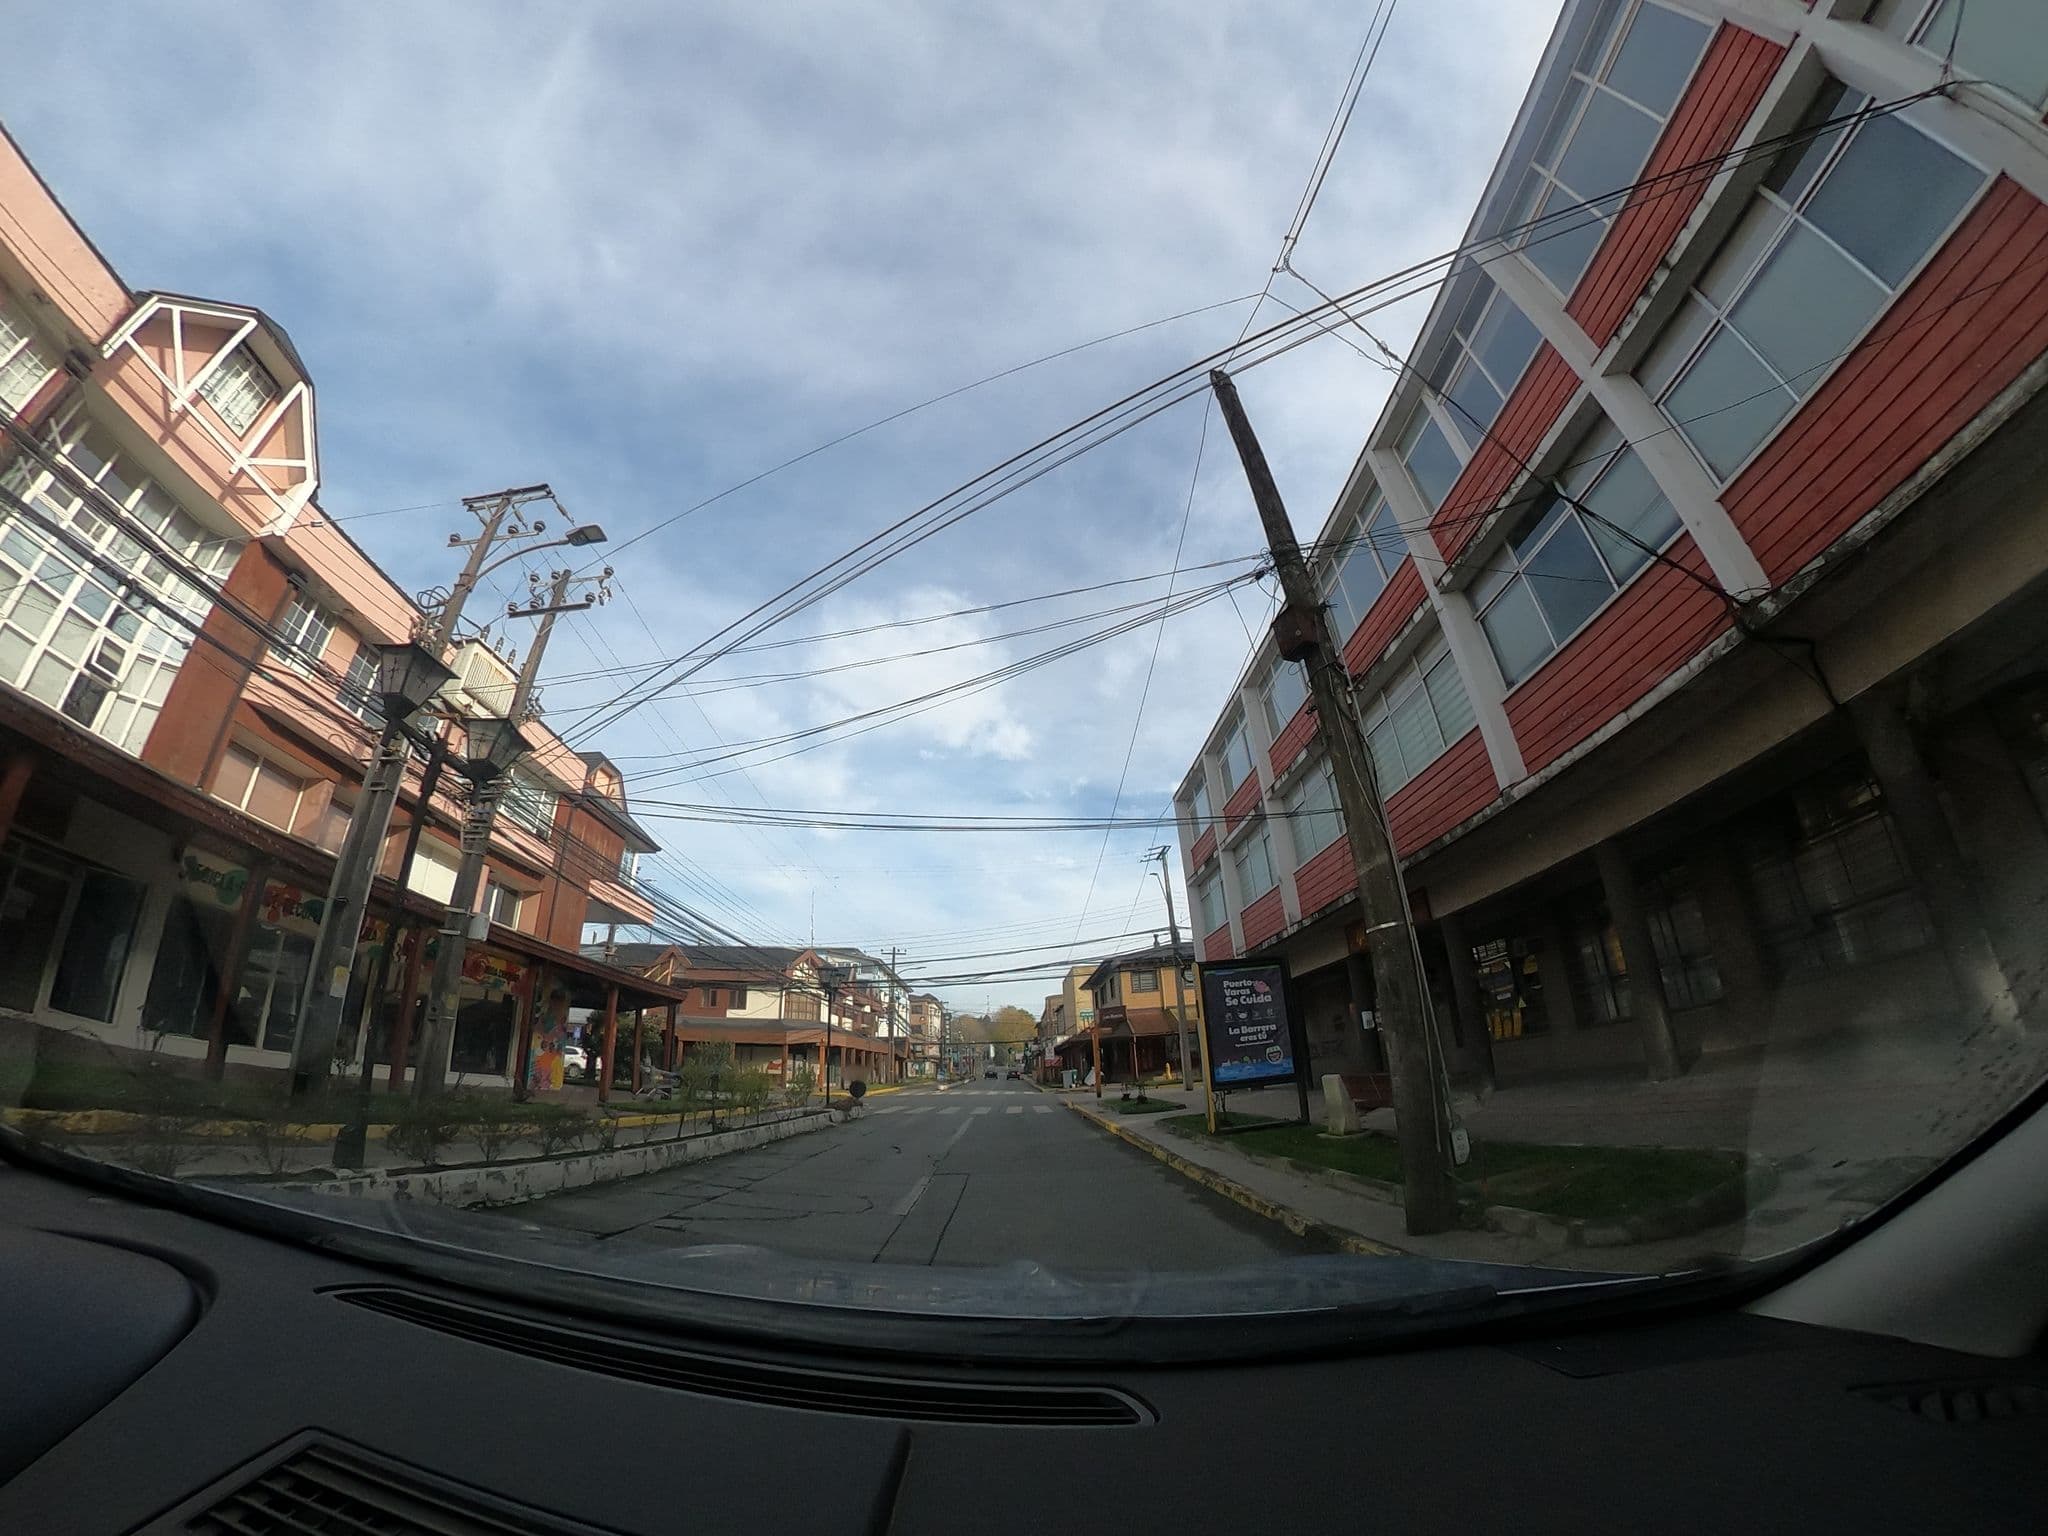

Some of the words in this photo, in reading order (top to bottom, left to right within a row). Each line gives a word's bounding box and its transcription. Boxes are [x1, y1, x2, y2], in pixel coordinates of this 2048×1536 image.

[1223, 980, 1252, 988] Puerto
[1224, 988, 1250, 996] Varas
[1225, 997, 1238, 1006] Se
[1240, 994, 1272, 1004] Cuida
[1229, 1026, 1240, 1035] La
[1241, 1024, 1277, 1033] Barrera
